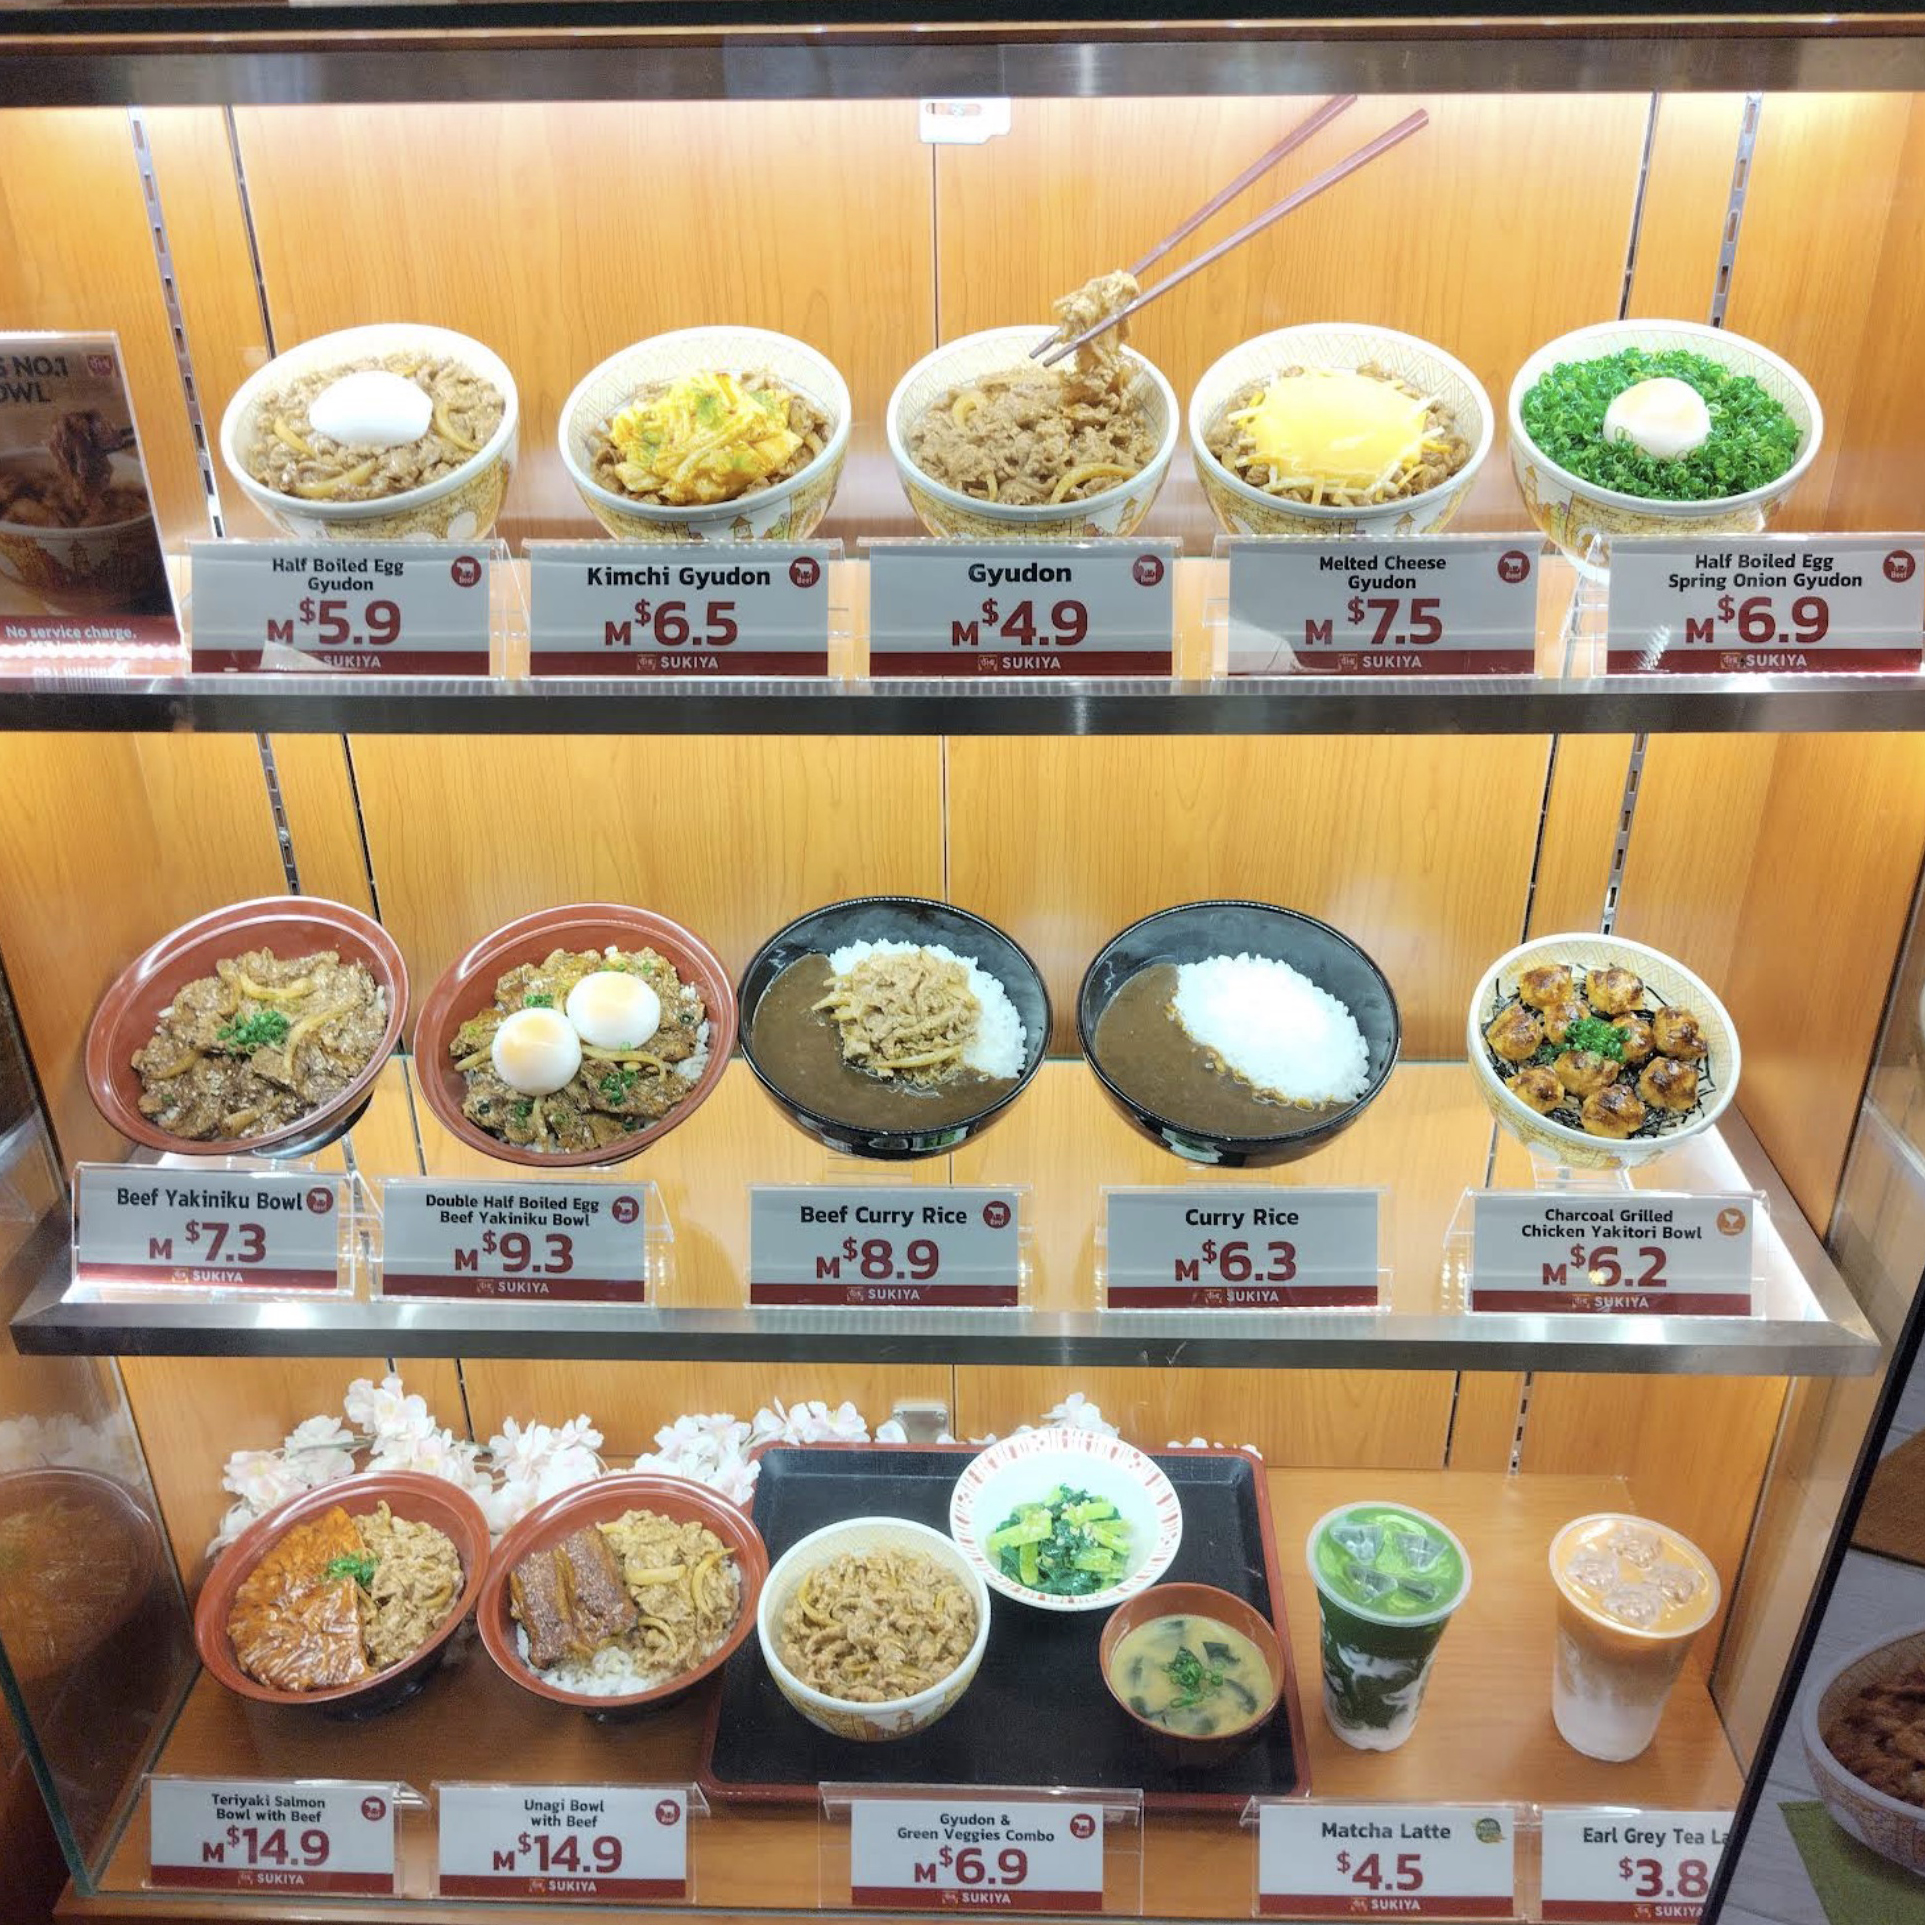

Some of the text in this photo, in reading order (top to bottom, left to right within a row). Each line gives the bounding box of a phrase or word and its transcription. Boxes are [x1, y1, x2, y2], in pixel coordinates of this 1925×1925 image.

[13, 356, 68, 377] NO.1
[273, 558, 403, 576] Half Boiled Egg
[1320, 555, 1446, 570] Melted Cheese
[1696, 554, 1833, 571] Half Boiled Egg
[588, 567, 770, 590] Kimchi Gyudon
[969, 563, 1071, 587] Gyudon
[1669, 573, 1862, 592] Spring Onion Gyudon
[308, 577, 373, 593] Gyudon
[1348, 575, 1416, 592] Gyudon
[268, 597, 400, 645] M $5.9
[605, 599, 737, 646] M $6.5
[952, 598, 1087, 646] M $4.9
[1306, 596, 1442, 645] M $7.5
[1686, 595, 1828, 643] M $6.9
[5, 625, 137, 641] No service charge.
[323, 656, 381, 668] SUKIYA
[661, 657, 718, 668] SUKIYA
[1003, 657, 1060, 668] SUKIYA
[1363, 656, 1421, 667] SUKIYA
[1746, 654, 1807, 666] SUKIYA
[118, 1188, 158, 1205] Beef
[166, 1190, 249, 1208] Yakiniku
[258, 1193, 302, 1210] Bowl
[427, 1195, 599, 1213] Double Half Boiled Egg
[441, 1211, 589, 1226] Beef Yakiniku Bowl
[801, 1206, 967, 1227] Beef Curry Rice
[1186, 1208, 1298, 1229] Curry Rice
[1545, 1209, 1672, 1222] Charcoal Grilled
[1522, 1225, 1702, 1239] Chicken Yakitori Bowl
[150, 1220, 266, 1263] M $7.3
[455, 1230, 573, 1273] M $9.3
[817, 1237, 938, 1279] M $8.9
[1175, 1239, 1296, 1282] M $6.3
[1543, 1243, 1666, 1287] M $6.2
[193, 1270, 244, 1283] SUKIYA
[498, 1282, 549, 1293] SUKIYA
[869, 1289, 920, 1301] SUKIYA
[1227, 1289, 1278, 1302] SUKIYA
[1595, 1297, 1648, 1309] SUKIYA
[212, 1794, 325, 1808] Teriyaki Salmon
[525, 1800, 604, 1814] Unagi Bowl
[217, 1808, 321, 1822] Bowl with Beef
[532, 1814, 597, 1827] with Beef
[940, 1814, 1010, 1827] Gyudon &
[898, 1828, 1054, 1843] Green Veggies Combo
[1322, 1823, 1450, 1838] Matcha Latte
[1584, 1827, 1617, 1843] Earl
[1625, 1828, 1666, 1847] Grey
[1673, 1828, 1704, 1844] Tea
[203, 1825, 329, 1866] M $14.9
[494, 1832, 622, 1873] M $14.9
[915, 1846, 1027, 1885] M $6.9
[1337, 1851, 1423, 1891] $4.5
[258, 1873, 304, 1884] SUKIYA
[1619, 1856, 1709, 1897] $3.8
[549, 1880, 596, 1891] SUKIYA
[962, 1893, 1010, 1903] SUKIYA
[1372, 1899, 1420, 1910] SUKIYA
